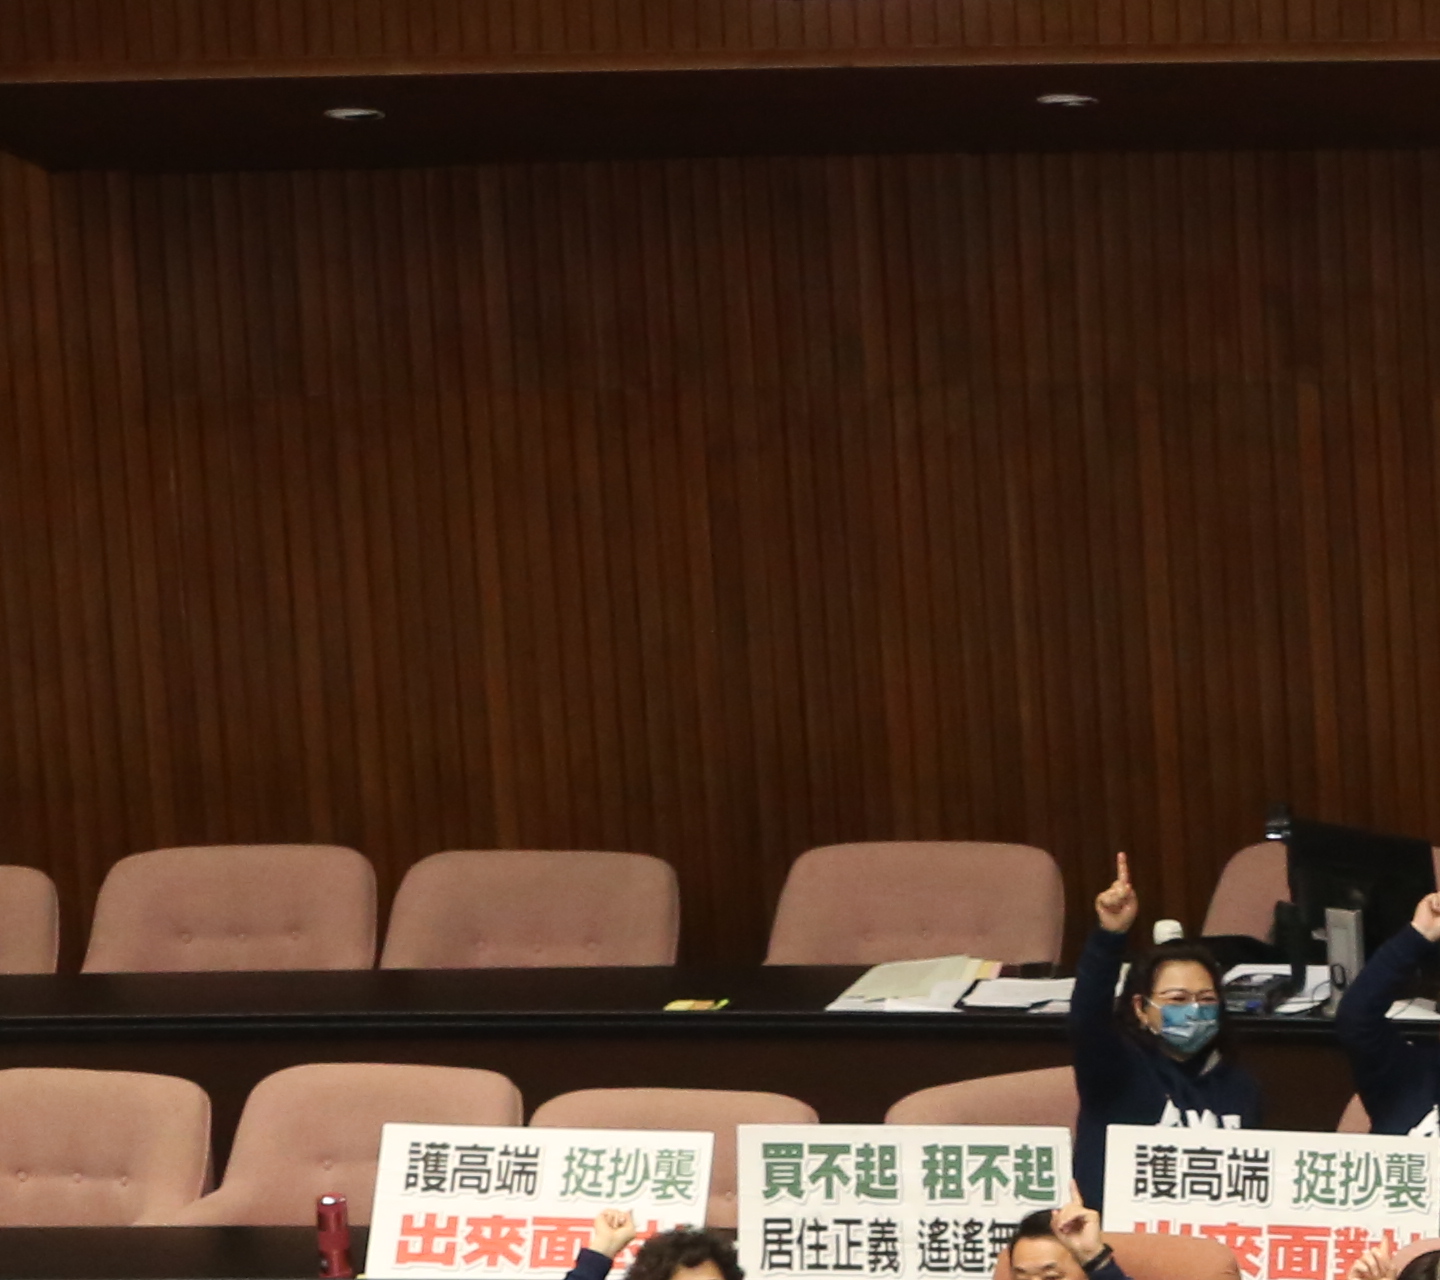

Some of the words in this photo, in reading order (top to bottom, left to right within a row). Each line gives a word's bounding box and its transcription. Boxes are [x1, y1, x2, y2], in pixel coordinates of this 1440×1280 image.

[405, 1141, 540, 1195] 護高端
[559, 1147, 697, 1201] 挺抄襲
[762, 1142, 899, 1199] 買不起
[922, 1144, 1055, 1201] 租不起
[1133, 1144, 1270, 1202] 護高端
[1292, 1150, 1427, 1209] 挺抄襲
[760, 1217, 899, 1273] 居住正義
